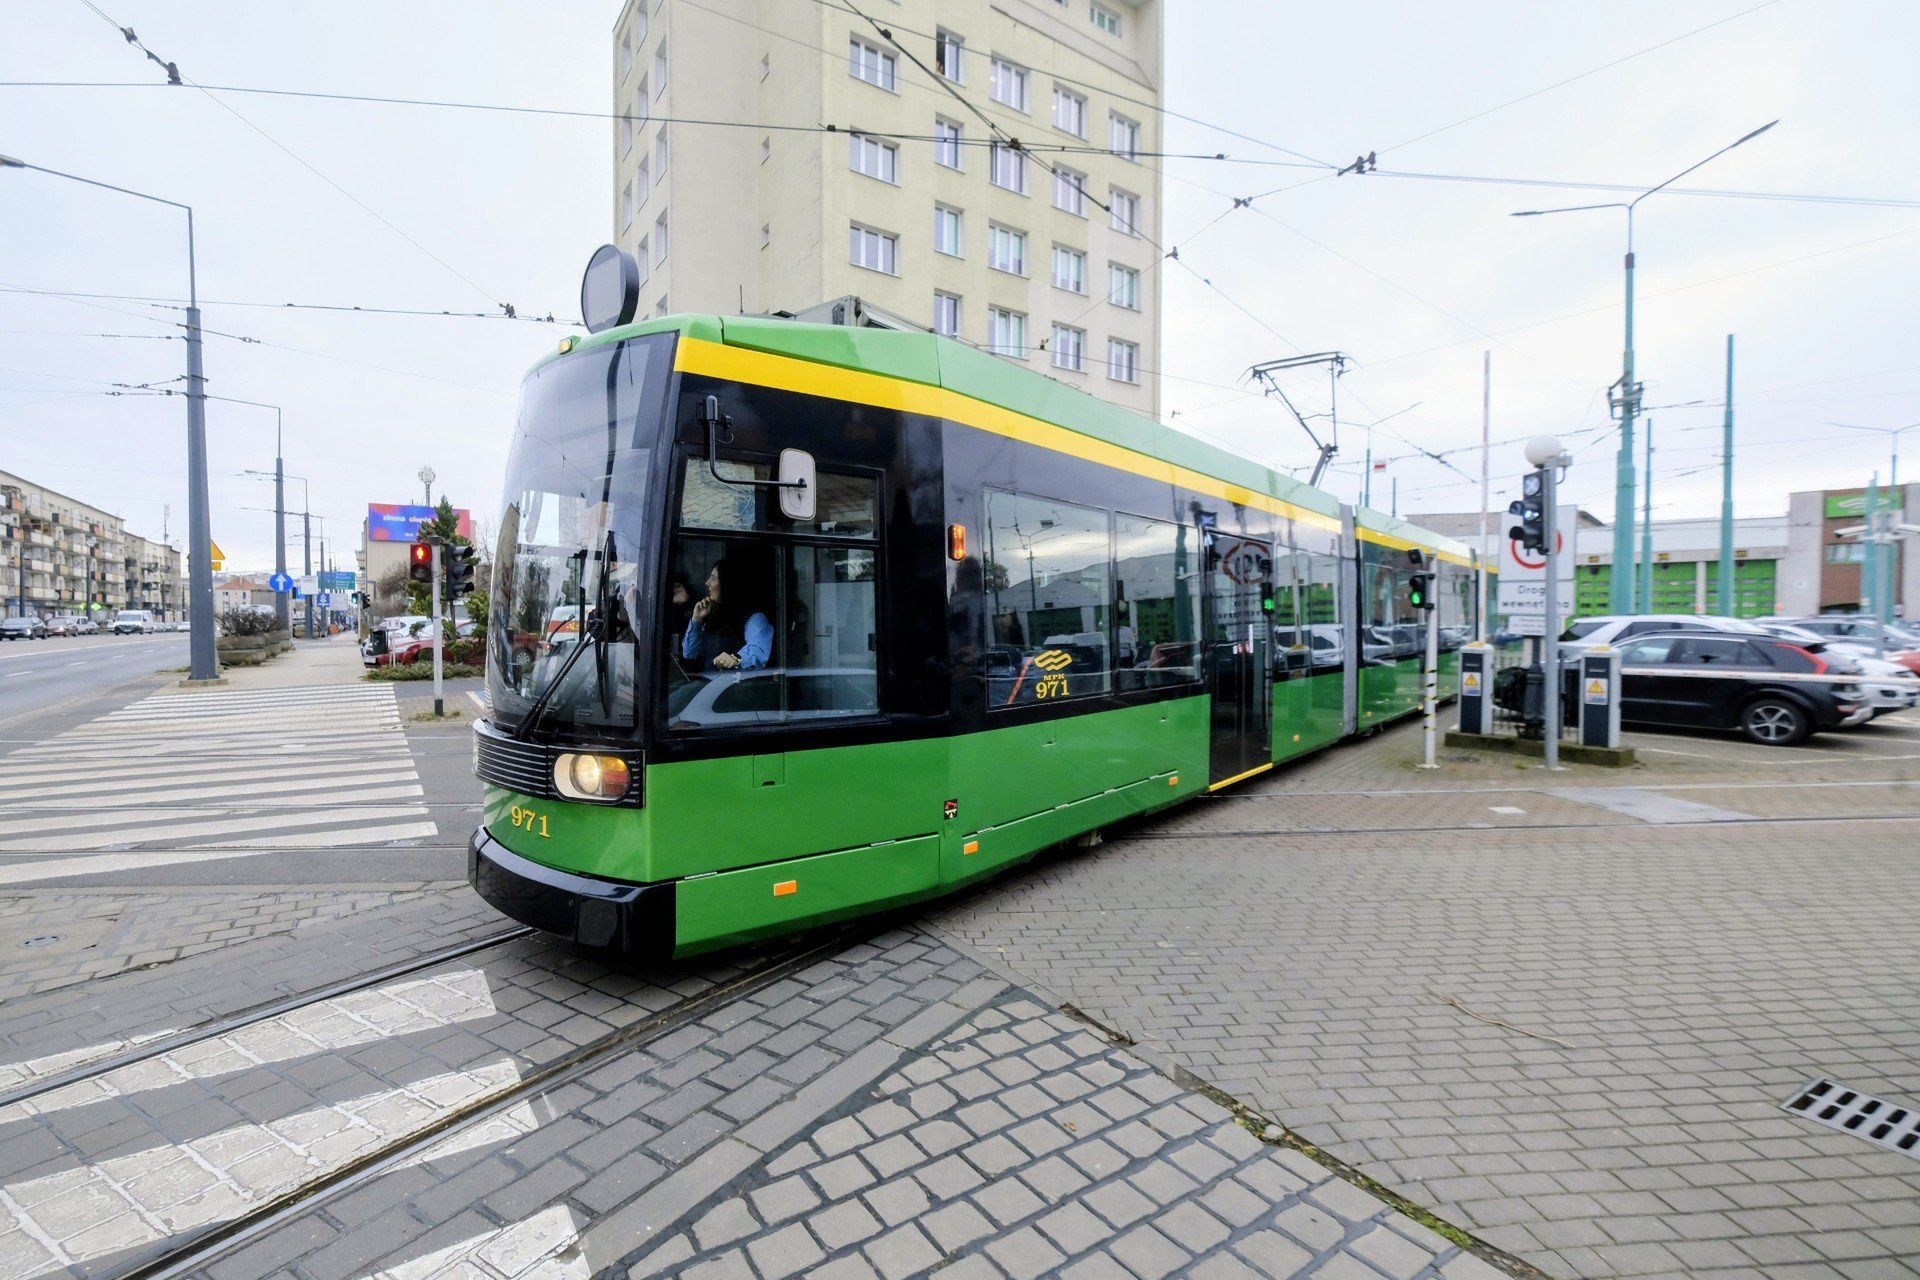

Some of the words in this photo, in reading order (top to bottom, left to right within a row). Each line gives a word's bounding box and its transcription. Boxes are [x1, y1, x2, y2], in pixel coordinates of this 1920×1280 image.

[1518, 585, 1546, 596] Drog
[1036, 680, 1070, 699] 971
[511, 805, 551, 839] 971
